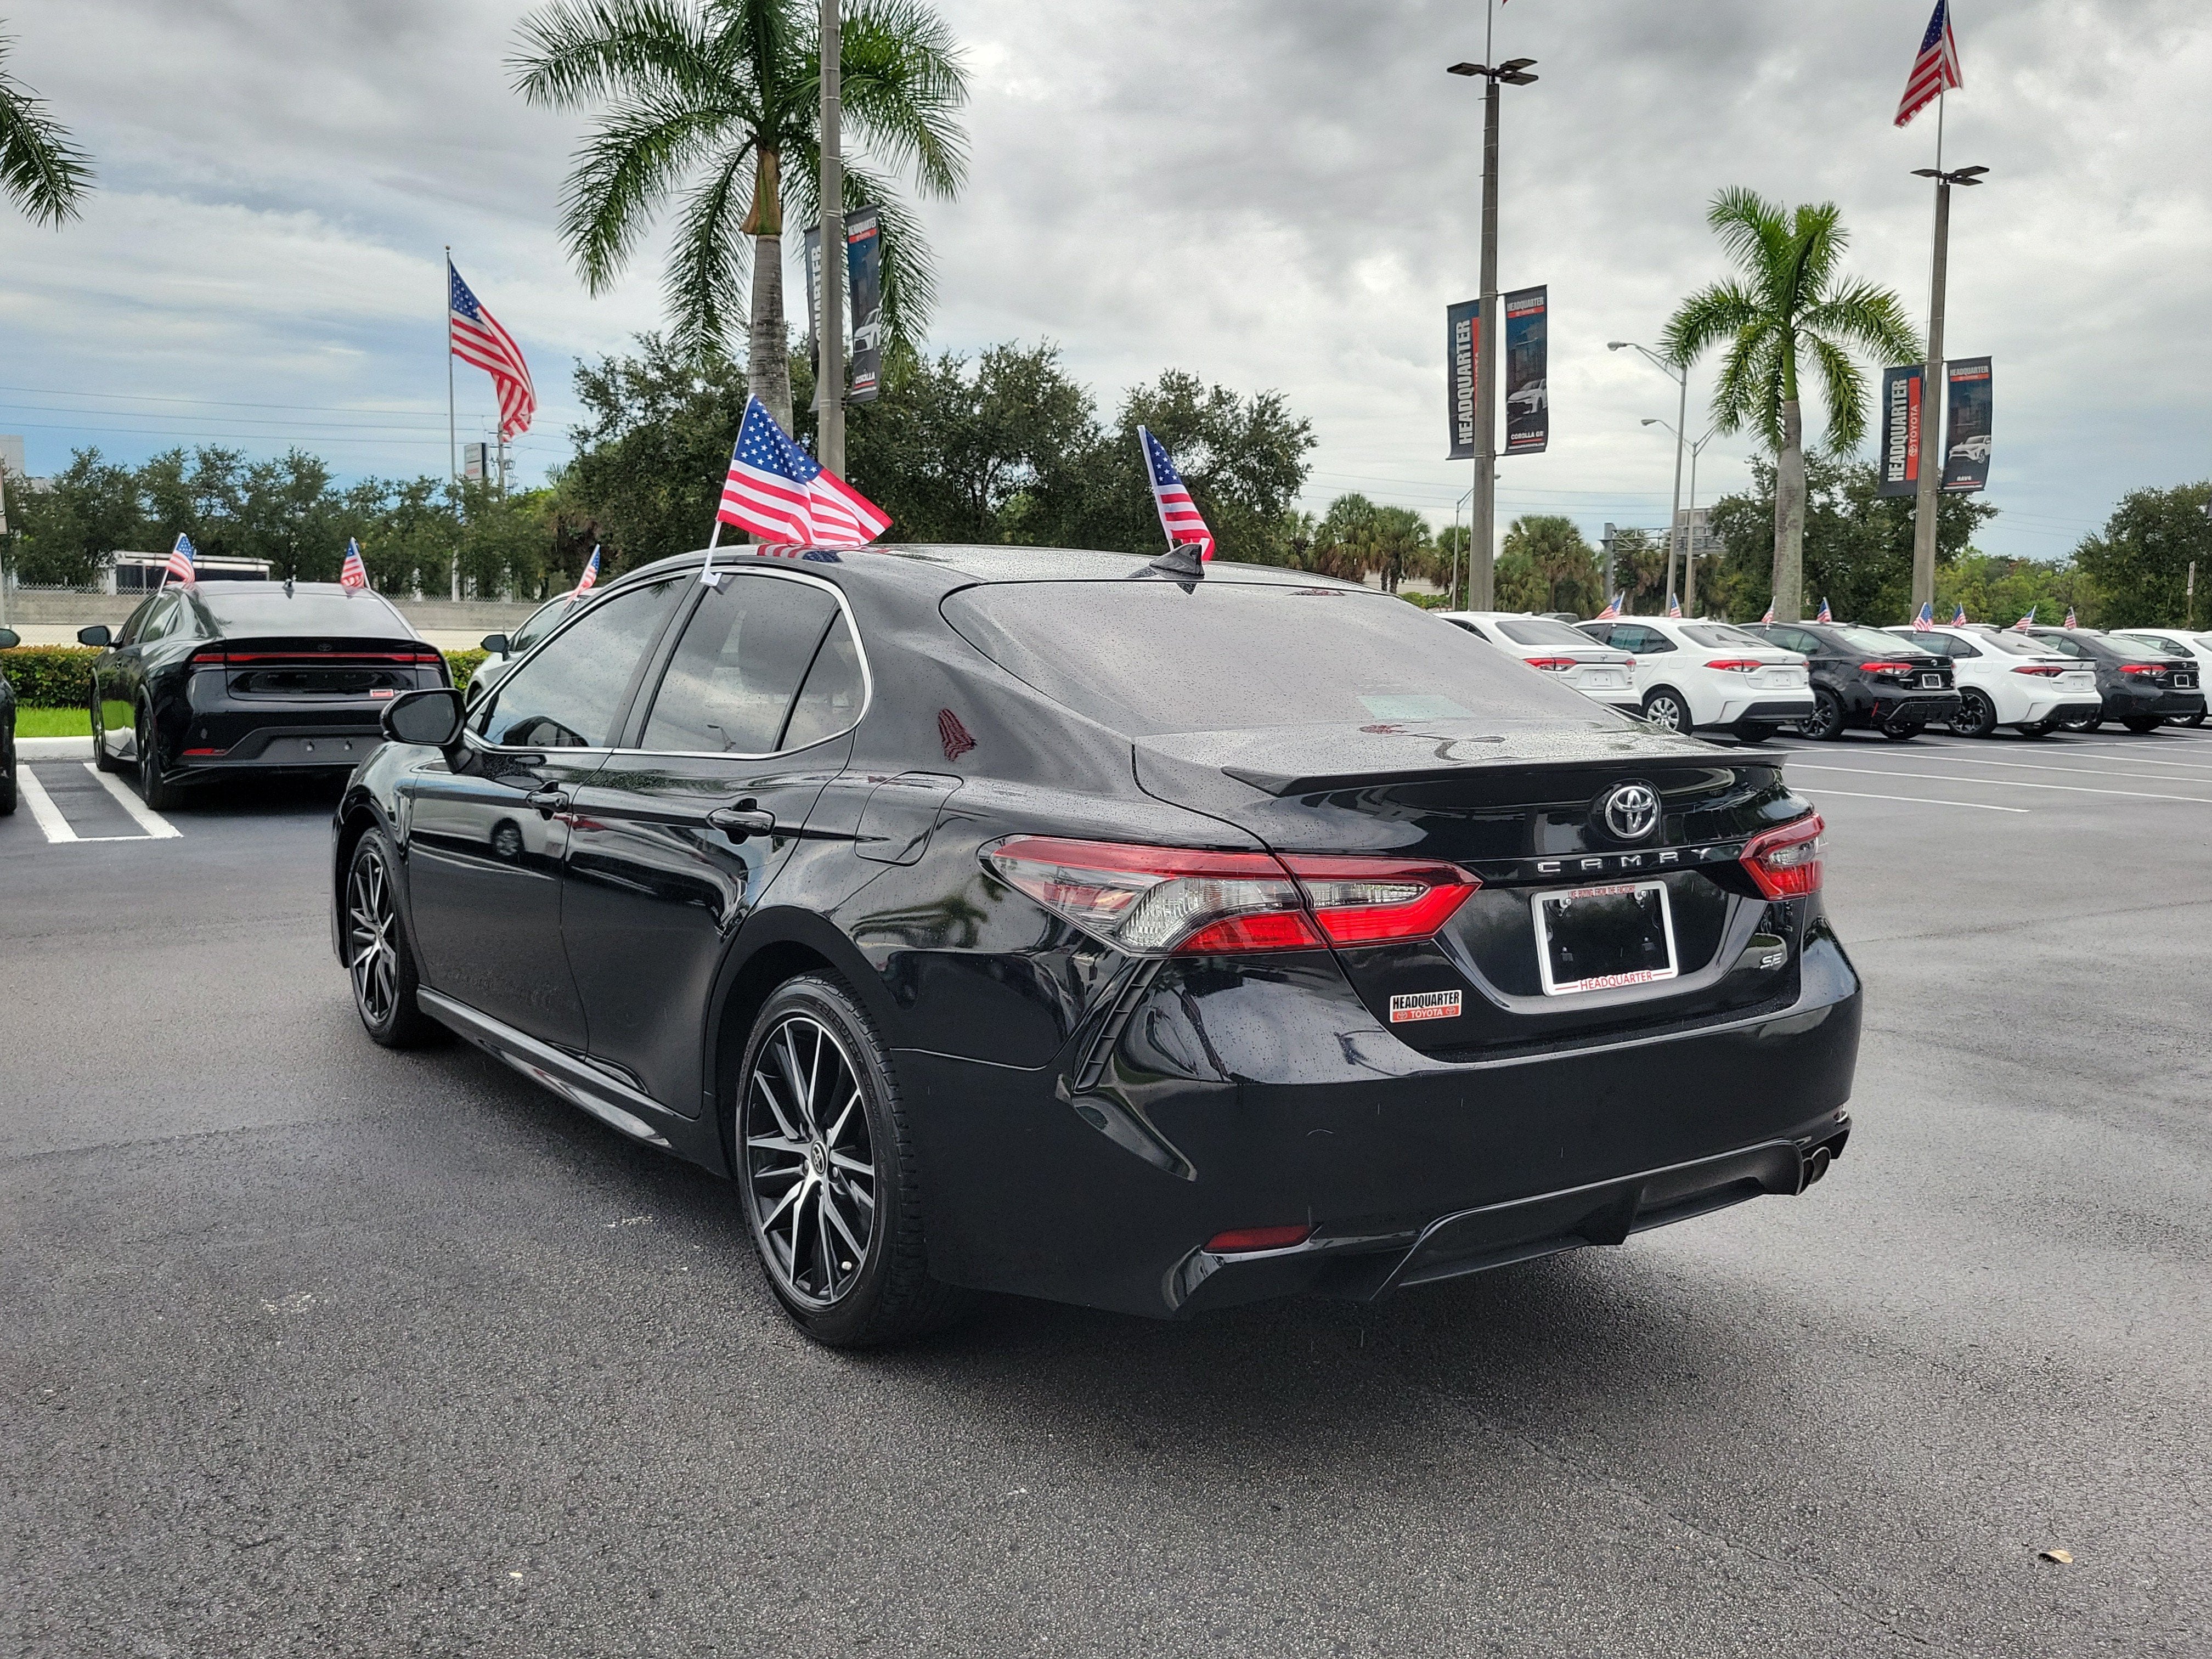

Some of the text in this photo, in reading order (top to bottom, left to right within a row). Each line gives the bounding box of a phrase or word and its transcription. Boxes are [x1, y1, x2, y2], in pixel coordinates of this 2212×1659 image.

[1949, 365, 1988, 376] HEADQUARTER
[1456, 320, 1474, 445] HEADQUARTER
[1887, 379, 1908, 482] HEADQUARTER
[1910, 404, 1918, 444] TOYOTA
[1510, 431, 1535, 440] COROLLA
[1537, 848, 1711, 873] CAMRY
[1760, 952, 1782, 969] SE
[1580, 971, 1652, 990] HEADQUARTER
[1393, 991, 1459, 1009] HEADQUARTER
[1410, 1008, 1443, 1018] TOYOTA
